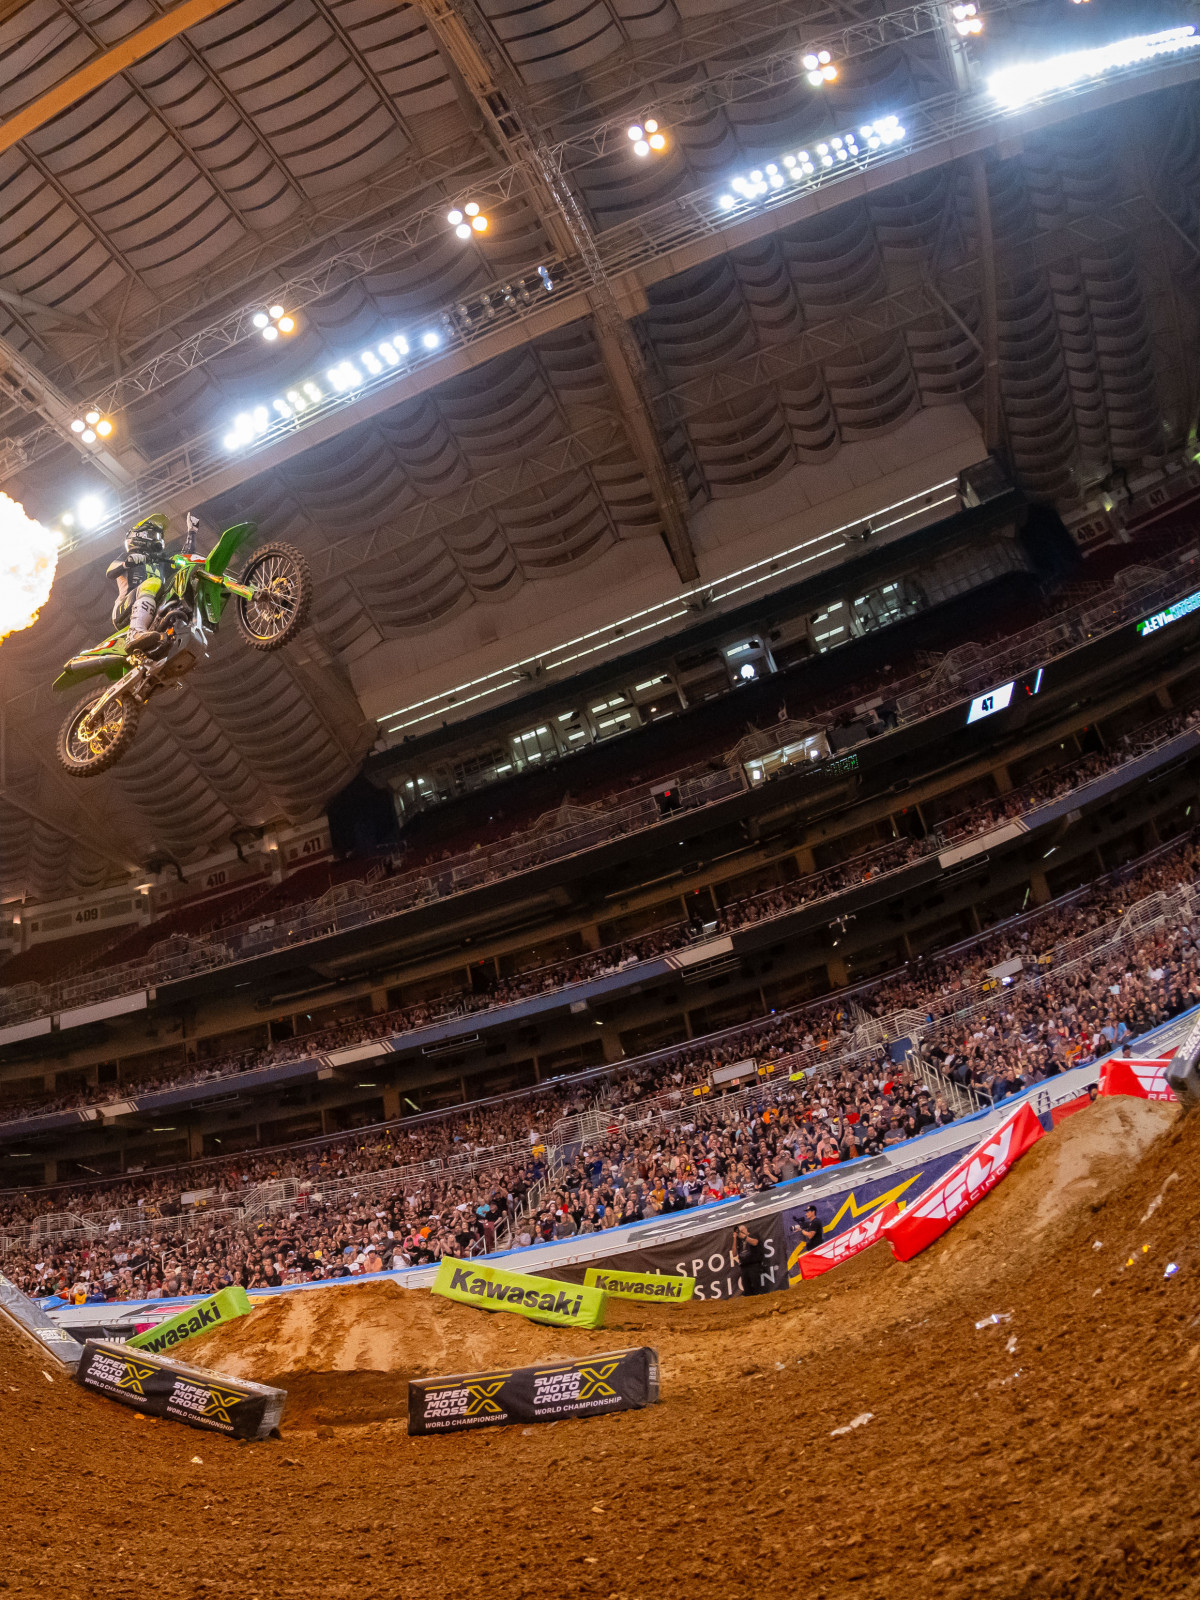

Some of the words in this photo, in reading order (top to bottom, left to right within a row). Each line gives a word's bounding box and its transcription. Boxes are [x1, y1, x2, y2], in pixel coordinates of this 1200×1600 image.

[981, 695, 994, 711] 47
[303, 837, 321, 854] 411
[206, 871, 226, 888] 410
[75, 907, 98, 923] 409
[946, 1165, 1007, 1222] RACING
[833, 1235, 875, 1262] RACING
[675, 1238, 775, 1277] SPORS
[449, 1268, 584, 1318] Kawasaki
[594, 1274, 683, 1297] Kawasaki
[137, 1301, 222, 1353] awasaki
[92, 1354, 127, 1371] SUPER
[92, 1362, 123, 1377] MOTO
[87, 1367, 122, 1384] CROSS
[533, 1372, 581, 1388] SUPER
[84, 1377, 104, 1391] WORLD
[104, 1384, 148, 1403] CHAMPIONSHIP
[172, 1381, 211, 1399] SUPER
[173, 1389, 208, 1405] MOTO
[424, 1388, 470, 1402] SUPER
[533, 1389, 580, 1405] CROSS
[536, 1381, 579, 1396] MOTO
[168, 1395, 206, 1412] CROSS
[423, 1405, 468, 1418] CROSS
[426, 1397, 468, 1410] MOTO
[534, 1405, 563, 1416] WORLD
[563, 1396, 622, 1412] CHAMPIONSHIP
[166, 1405, 188, 1419] WORLD
[187, 1412, 235, 1432] CHAMPIONSHIP
[425, 1420, 451, 1429] WORLD
[451, 1413, 508, 1427] CHAMPIONSHIP
